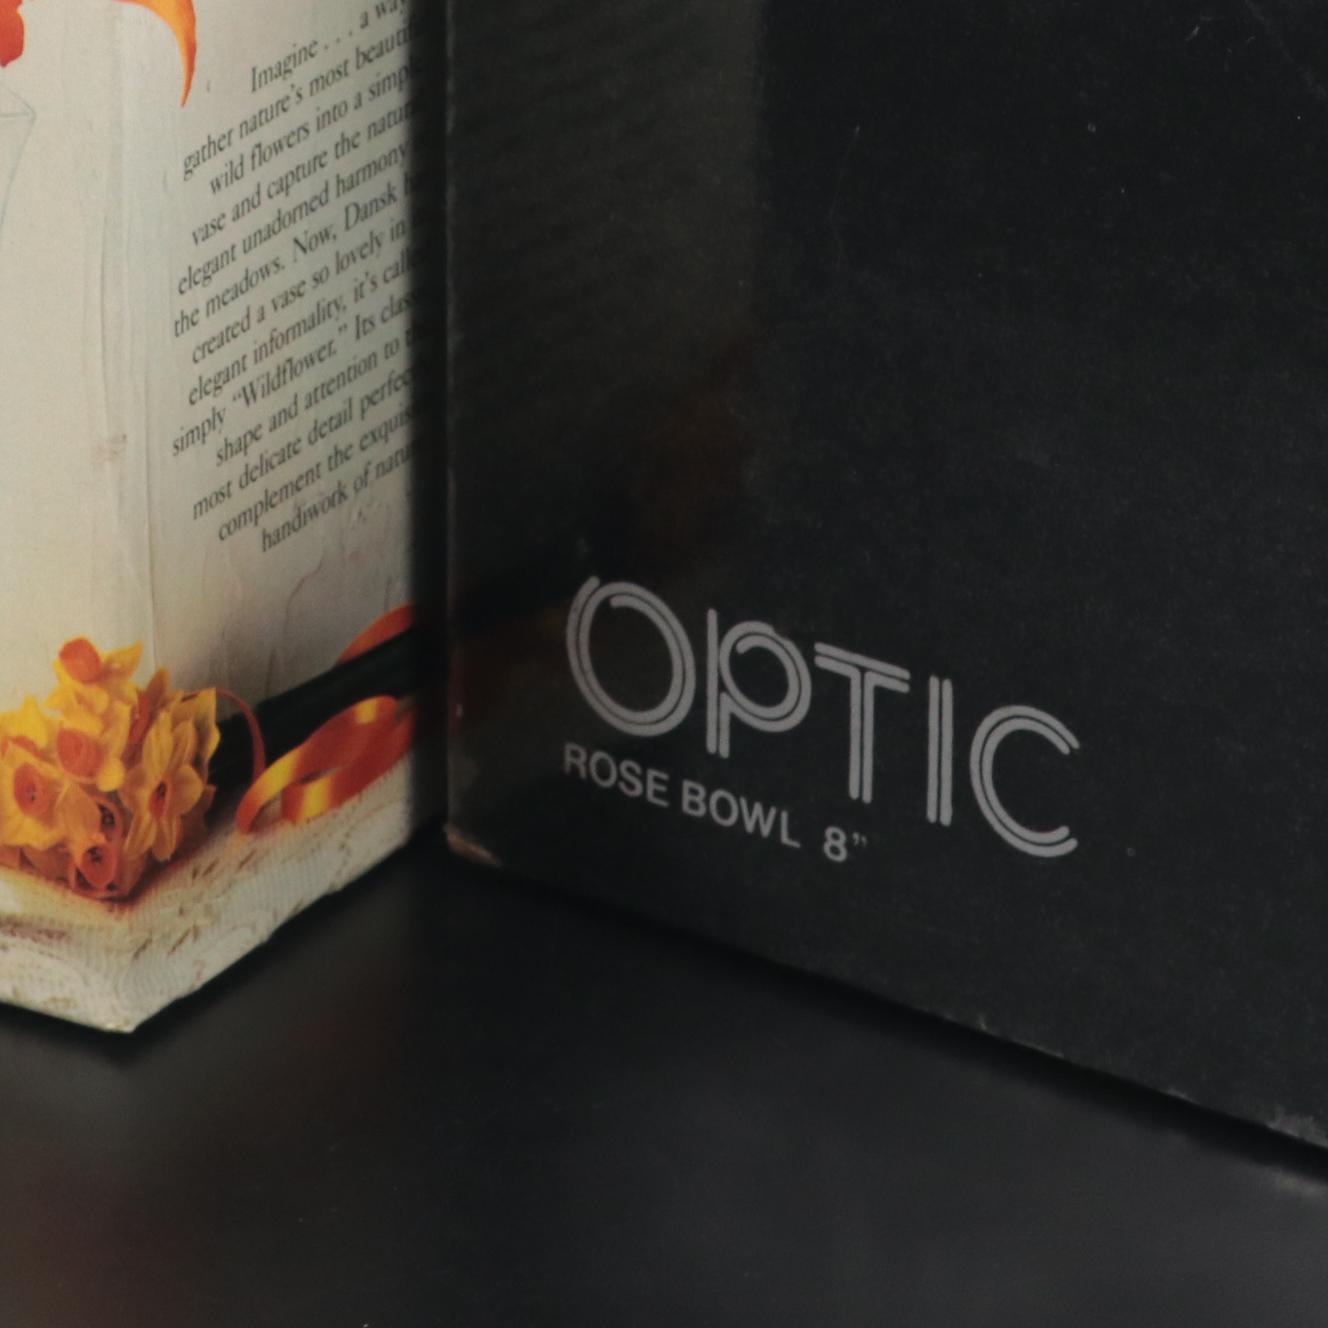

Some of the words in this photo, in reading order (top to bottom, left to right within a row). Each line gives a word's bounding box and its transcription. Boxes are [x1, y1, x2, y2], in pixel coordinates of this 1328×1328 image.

[250, 38, 319, 93] Imagine
[359, 10, 370, 30] a
[183, 128, 234, 182] gather
[238, 84, 304, 143] nature's
[309, 56, 351, 97] most
[209, 158, 246, 196] wild
[249, 122, 311, 173] flowers
[315, 101, 349, 134] into
[353, 91, 364, 111] a
[177, 242, 237, 296] elegant
[241, 179, 331, 256] unadorned
[335, 142, 410, 200] harmony
[190, 212, 228, 249] vase
[231, 180, 262, 224] and
[266, 148, 329, 203] capture
[334, 130, 361, 160] the
[173, 307, 200, 339] the
[204, 256, 286, 320] meadows.
[292, 221, 339, 264] Now,
[343, 181, 398, 233] Dansk
[191, 305, 251, 365] created
[255, 304, 266, 324] a
[269, 280, 307, 313] vase
[312, 264, 330, 289] so
[334, 228, 385, 276] lovely
[389, 217, 408, 243] in
[172, 404, 227, 458] simply
[354, 314, 377, 342] Its
[188, 354, 248, 406] elegant
[252, 294, 349, 369] informality,
[353, 270, 379, 305] it's
[191, 479, 234, 521] most
[238, 444, 302, 490] delicate
[306, 397, 355, 447] detail
[215, 422, 264, 468] shape
[268, 392, 300, 434] and
[304, 348, 379, 411] attention
[383, 335, 401, 361] to
[217, 461, 322, 543] complement
[326, 441, 354, 473] the
[260, 480, 350, 554] handiwork
[352, 456, 373, 494] of
[565, 574, 1081, 859] OPTIC
[563, 740, 670, 808] ROSE
[680, 777, 803, 850] BOWL
